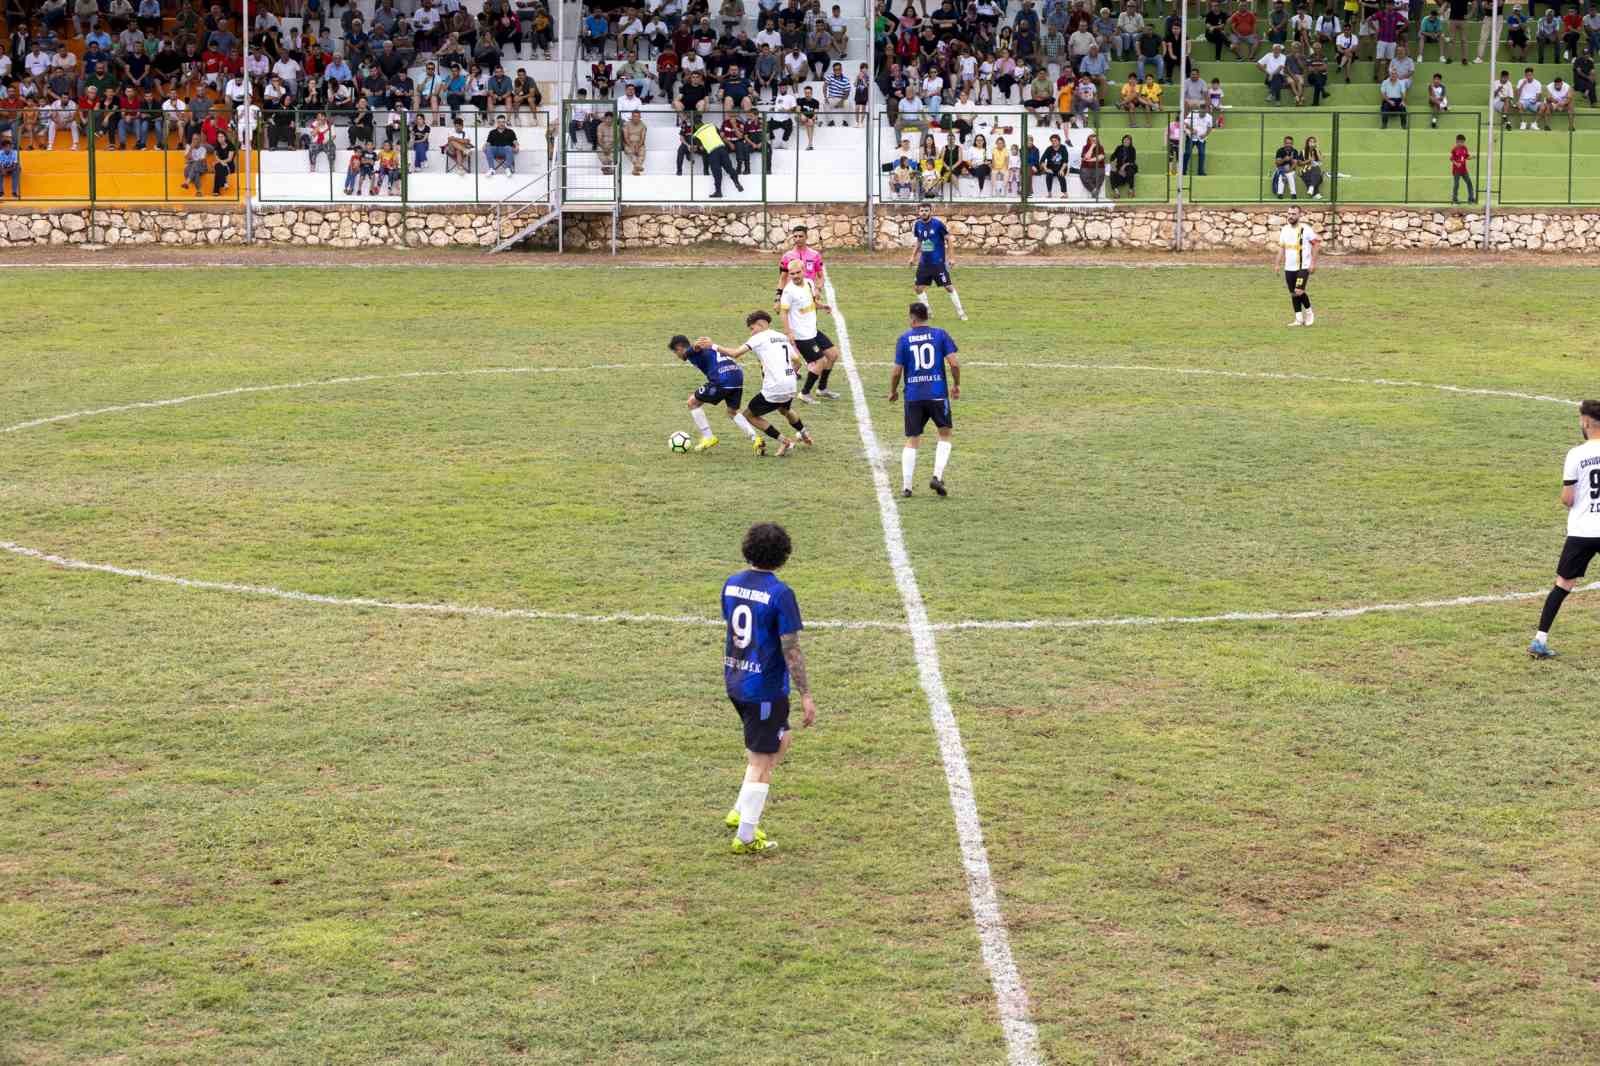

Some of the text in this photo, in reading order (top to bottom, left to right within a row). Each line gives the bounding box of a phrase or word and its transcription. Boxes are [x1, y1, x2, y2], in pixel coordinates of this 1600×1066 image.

[909, 343, 935, 370] 10
[1589, 469, 1600, 499] 9
[732, 605, 752, 648] 9
